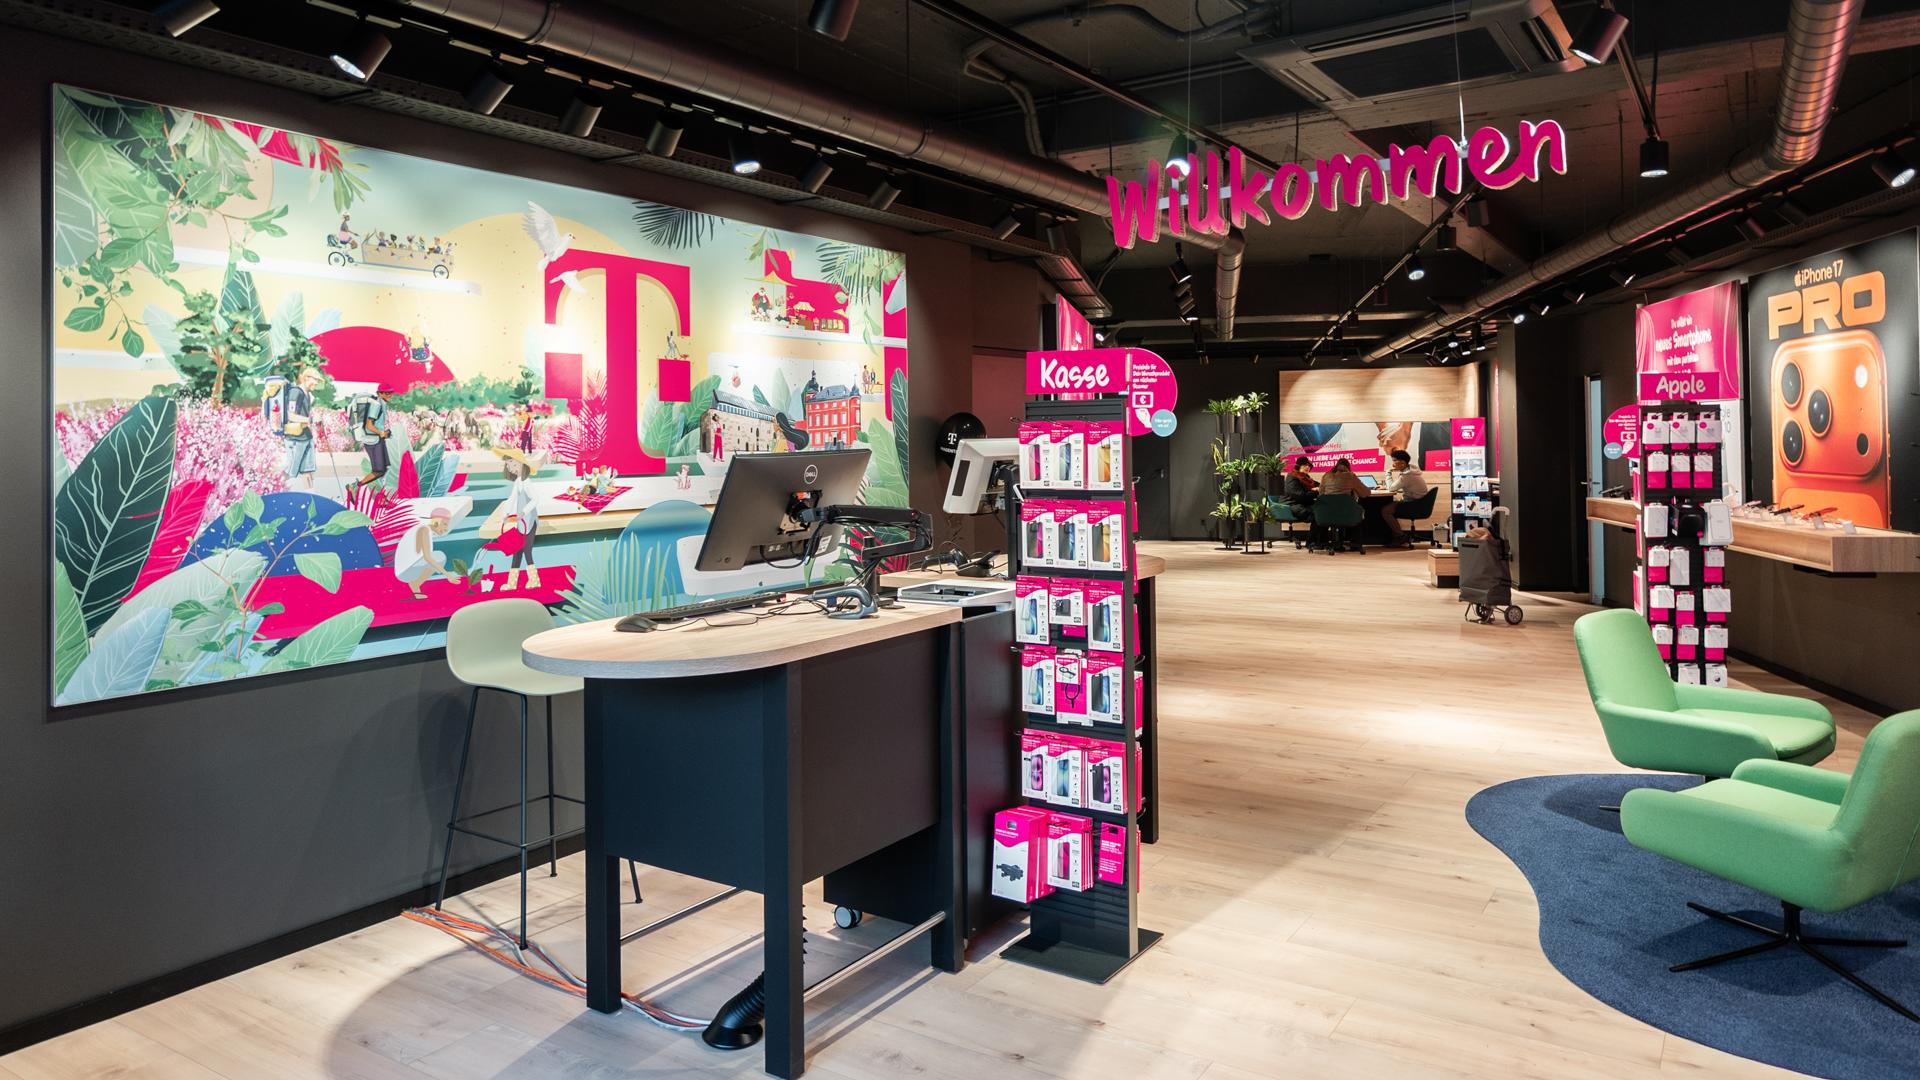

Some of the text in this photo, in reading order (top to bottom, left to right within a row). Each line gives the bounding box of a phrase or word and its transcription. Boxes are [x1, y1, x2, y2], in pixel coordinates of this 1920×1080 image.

[1105, 119, 1567, 250] Willkommen
[1801, 259, 1844, 285] iPhone 17
[1768, 270, 1886, 340] PRO
[1673, 325, 1712, 351] Smartphone
[1040, 357, 1110, 390] Kasse
[1655, 374, 1706, 399] Apple
[1352, 457, 1378, 465] CHANCE.
